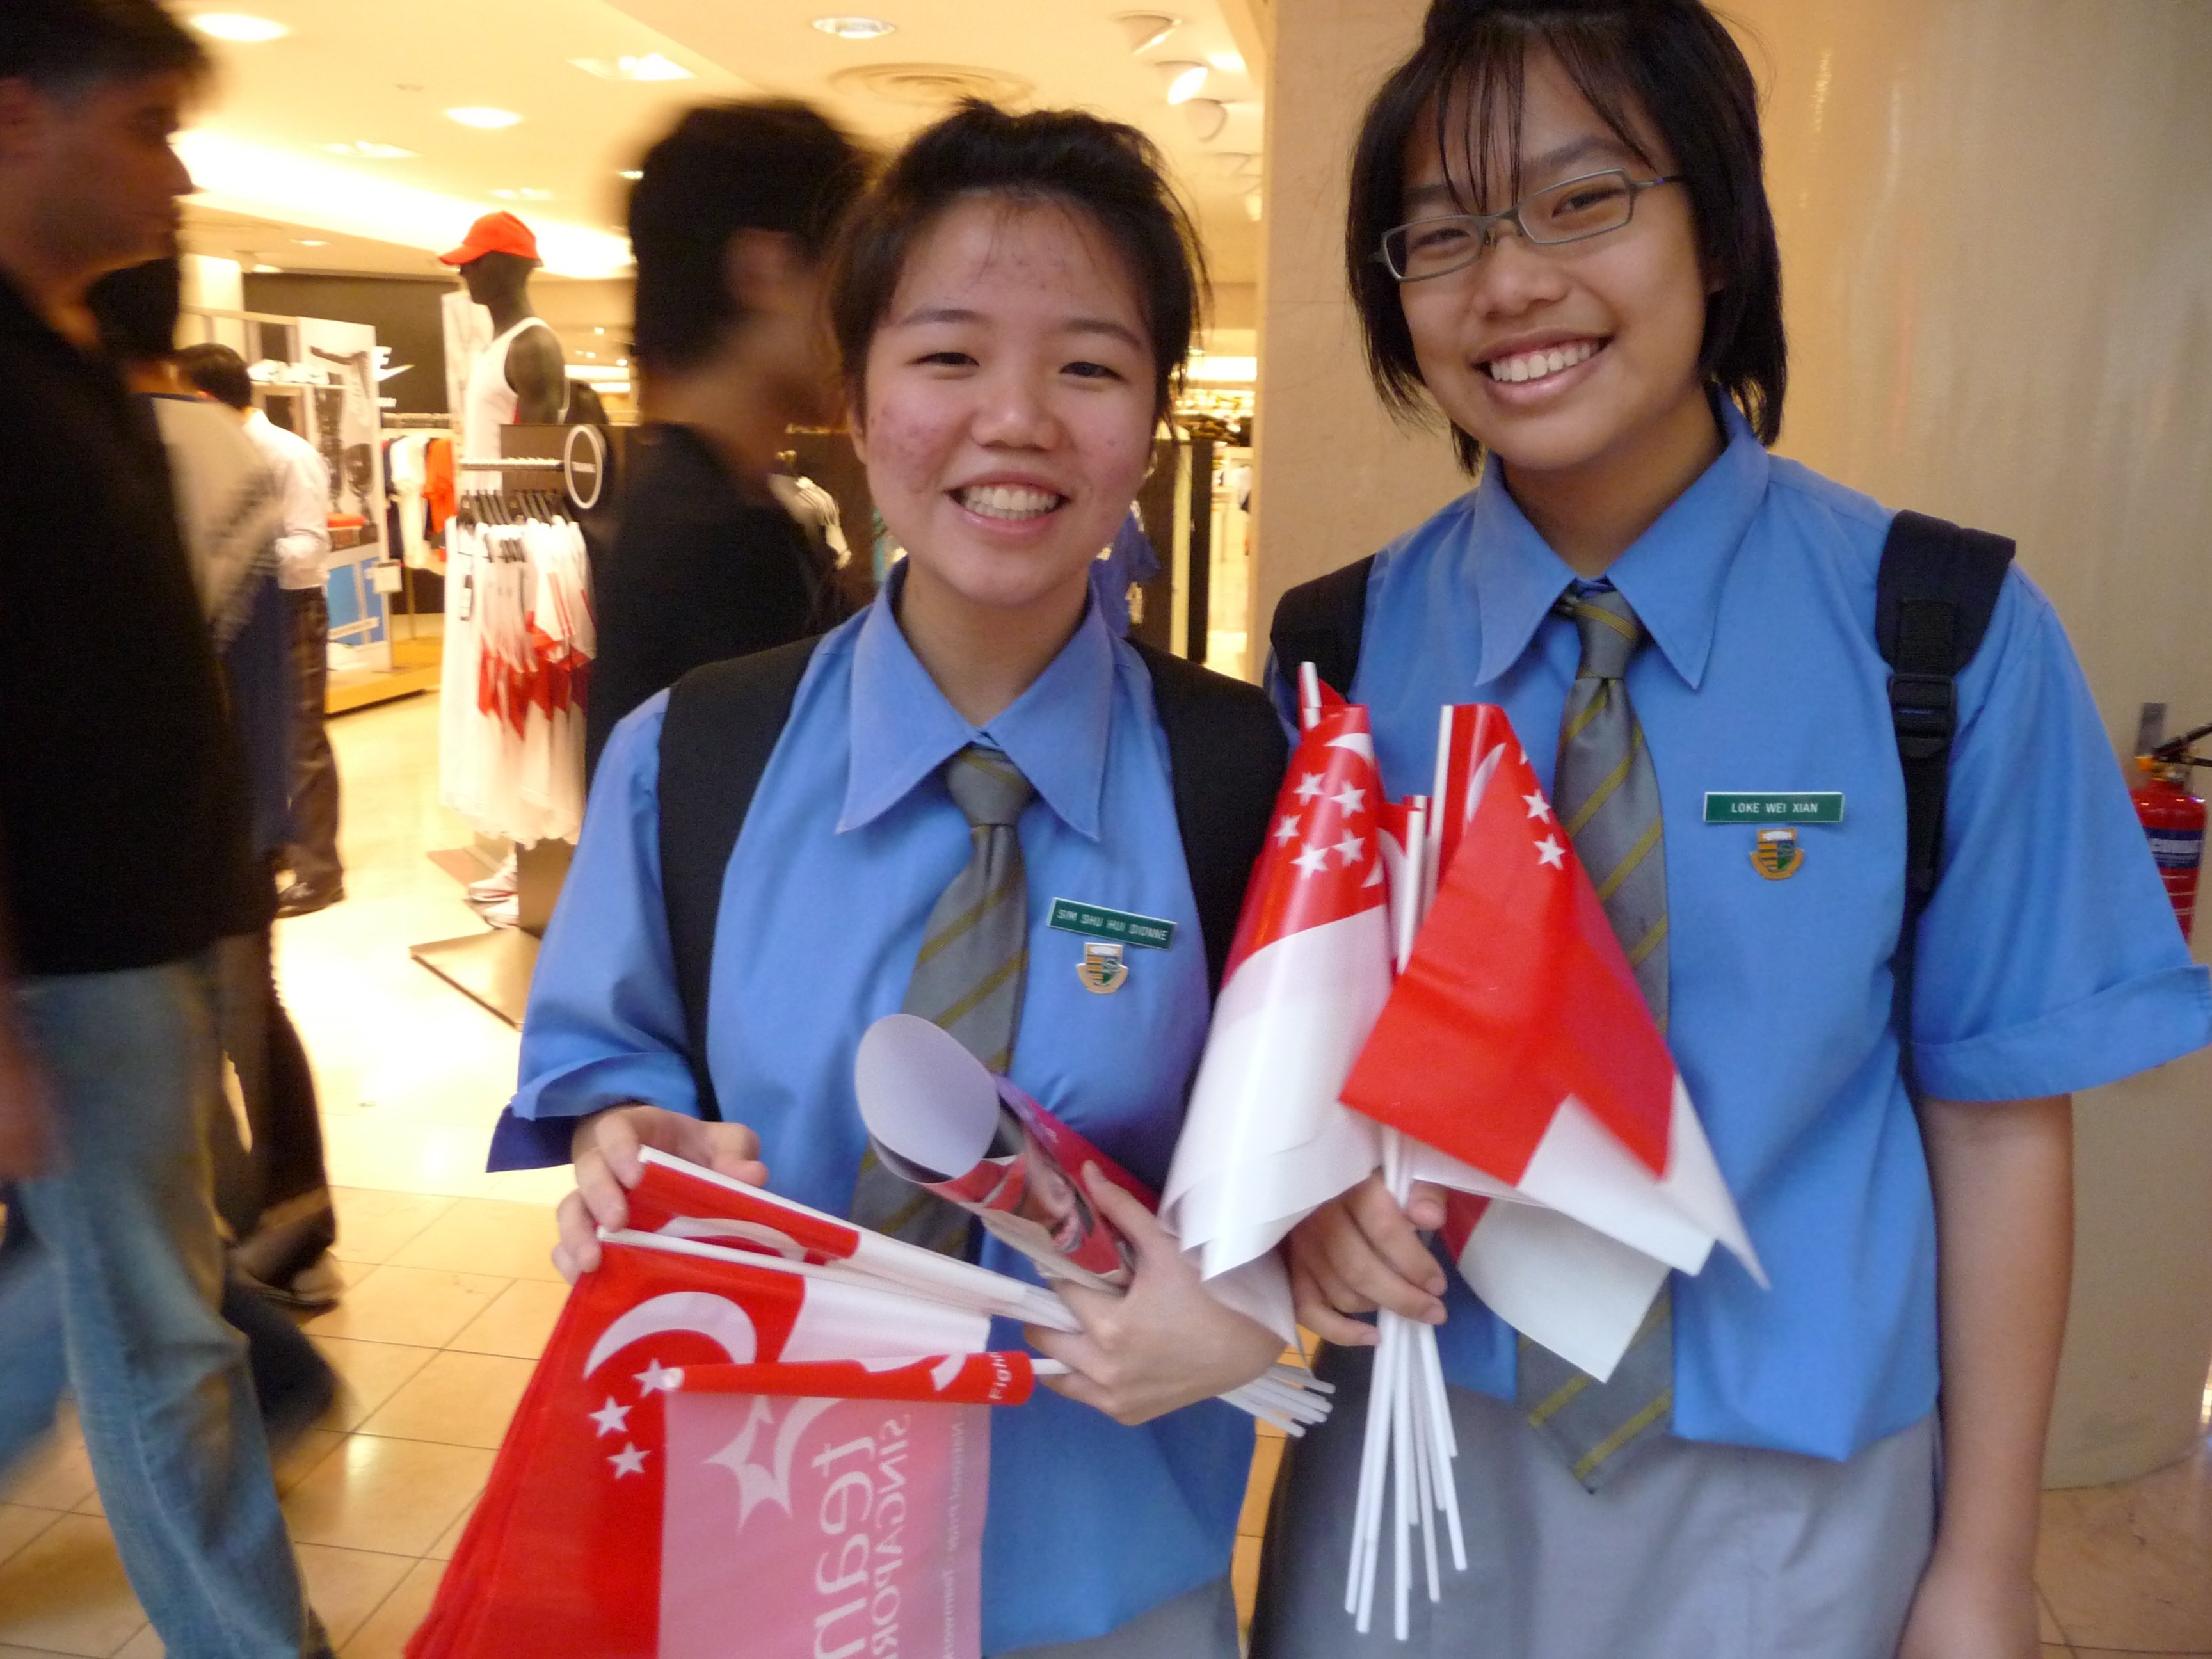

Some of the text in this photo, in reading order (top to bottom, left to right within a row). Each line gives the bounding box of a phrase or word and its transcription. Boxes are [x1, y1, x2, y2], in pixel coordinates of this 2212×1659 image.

[1731, 803, 1818, 813] LOKE WEI XIAN
[1057, 909, 1077, 922] SIM
[1080, 914, 1103, 927] SHU
[1107, 919, 1126, 932] HUI
